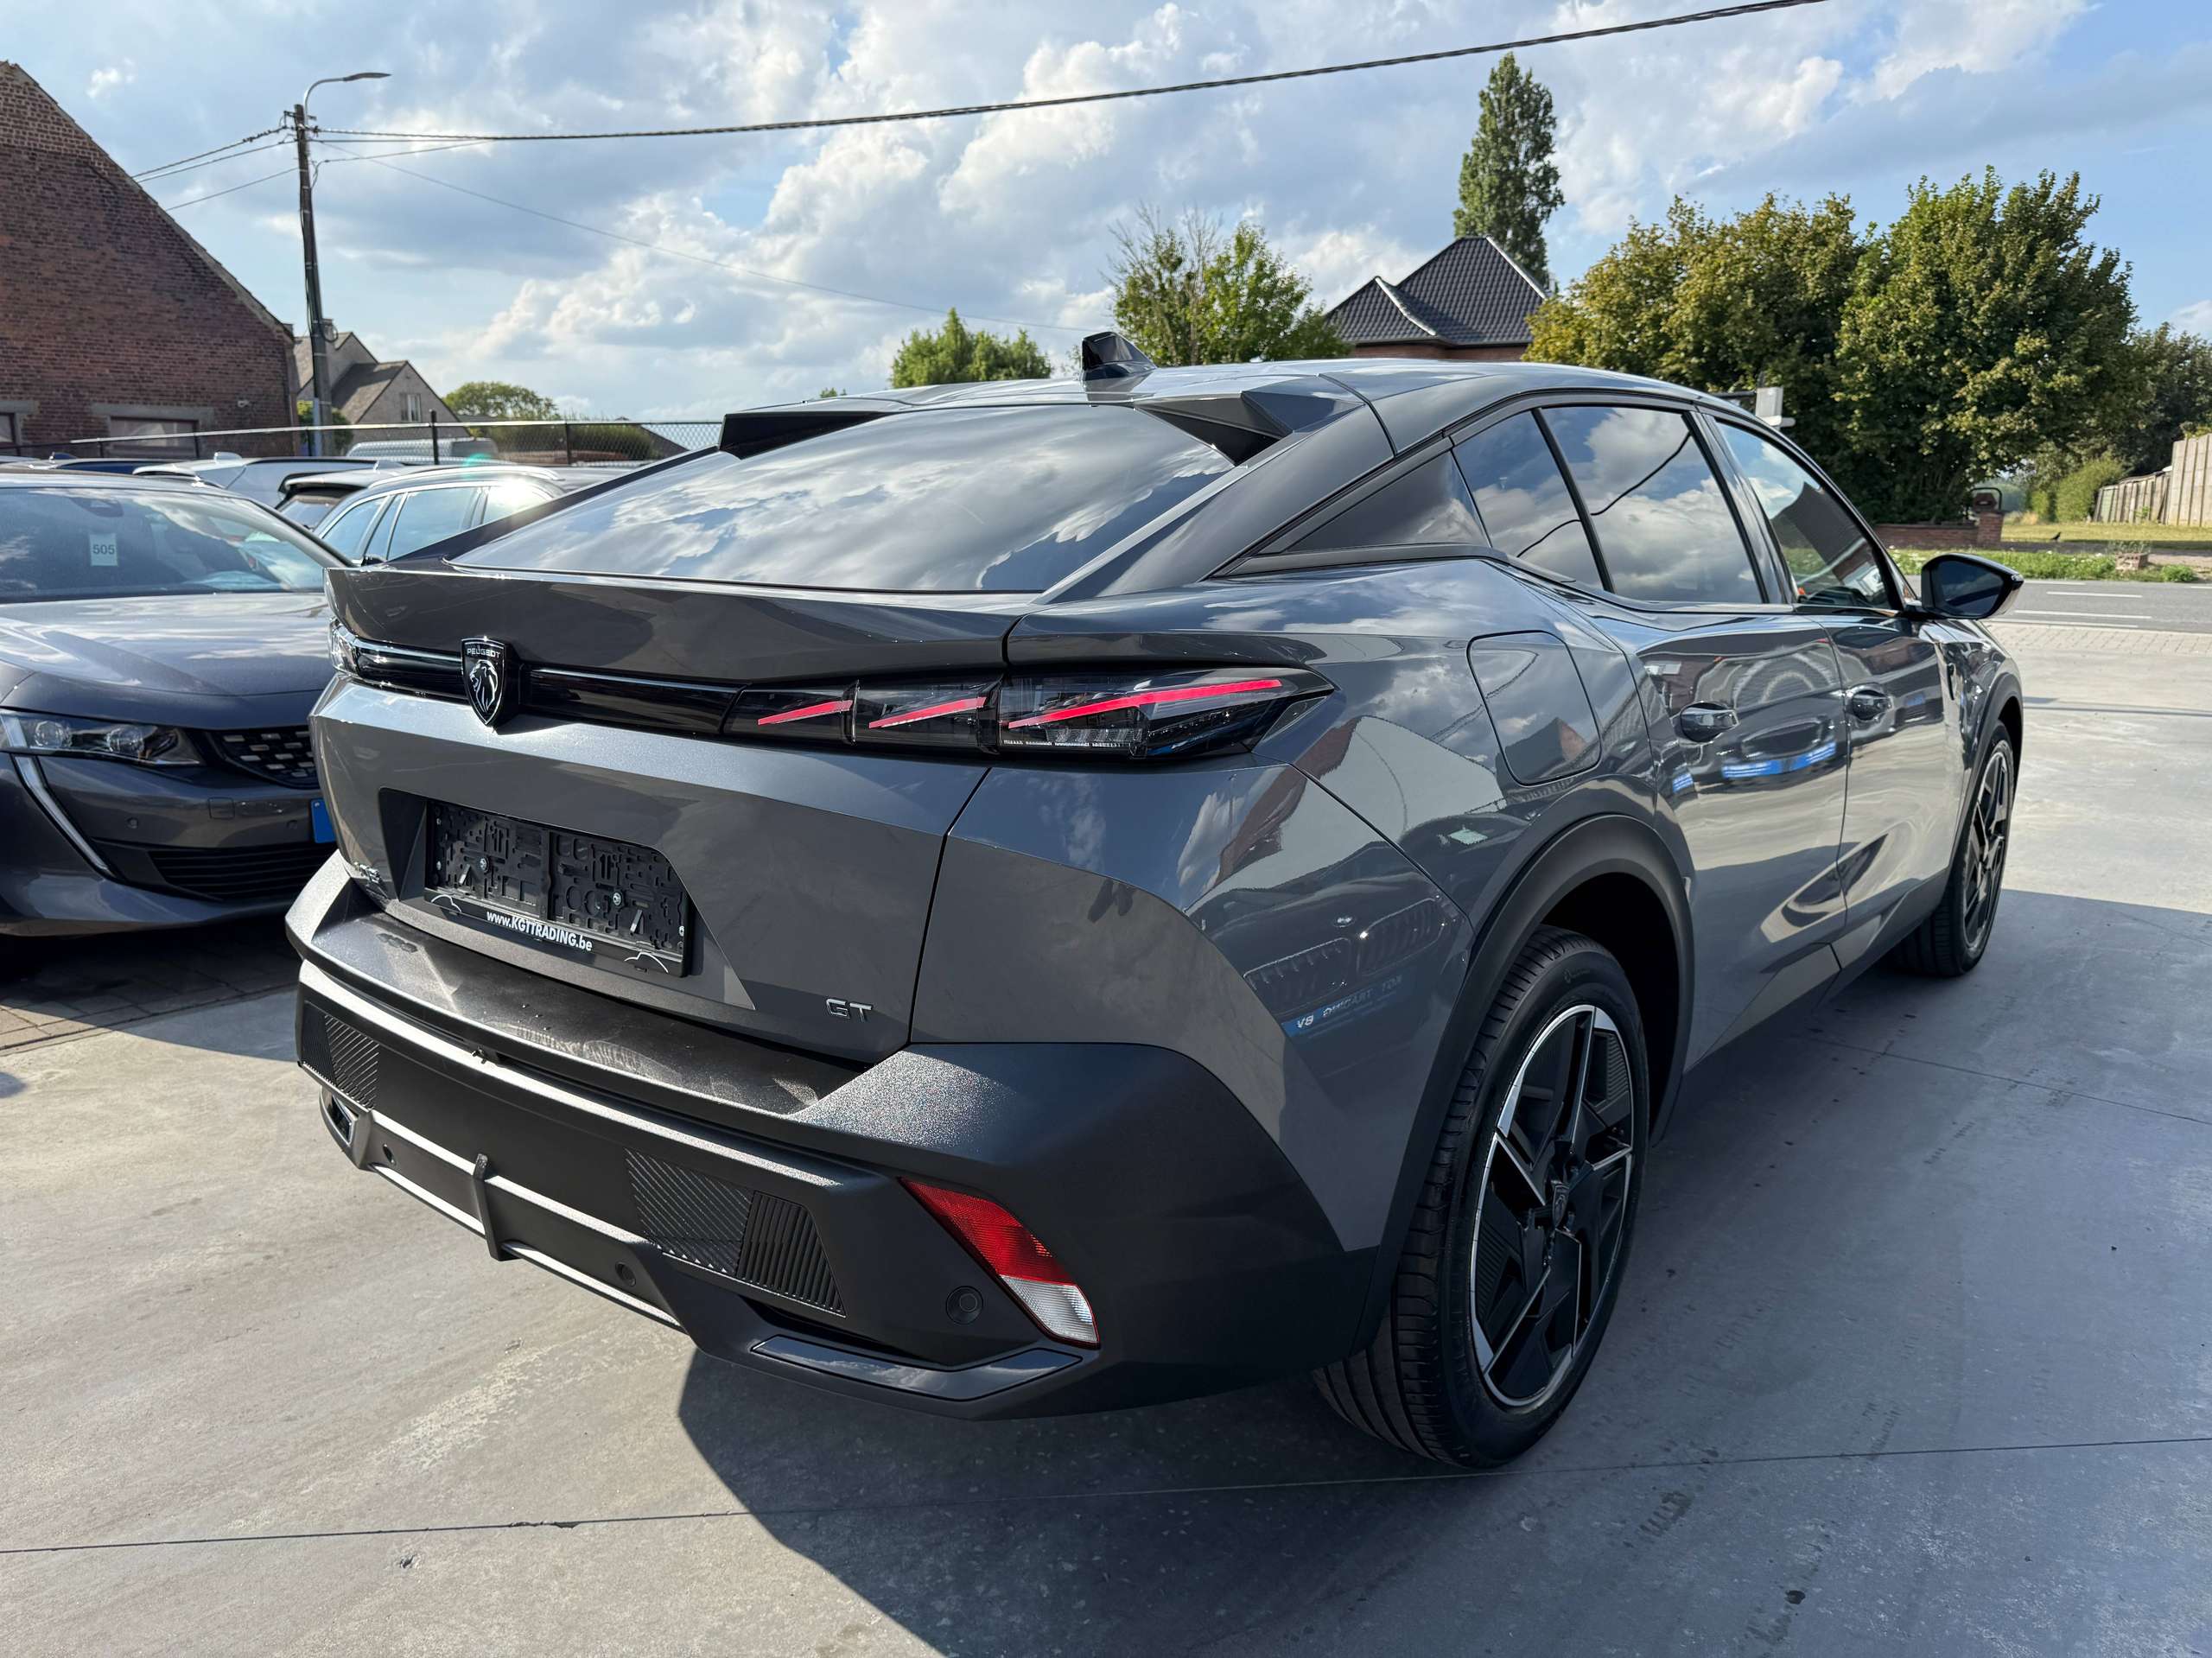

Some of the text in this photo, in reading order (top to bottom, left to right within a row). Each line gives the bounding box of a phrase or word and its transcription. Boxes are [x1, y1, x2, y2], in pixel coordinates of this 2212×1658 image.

[93, 544, 115, 555] 505
[467, 648, 501, 658] PEUGEOT
[486, 911, 593, 951] www.KGTTRADING.be
[826, 998, 873, 1021] GT
